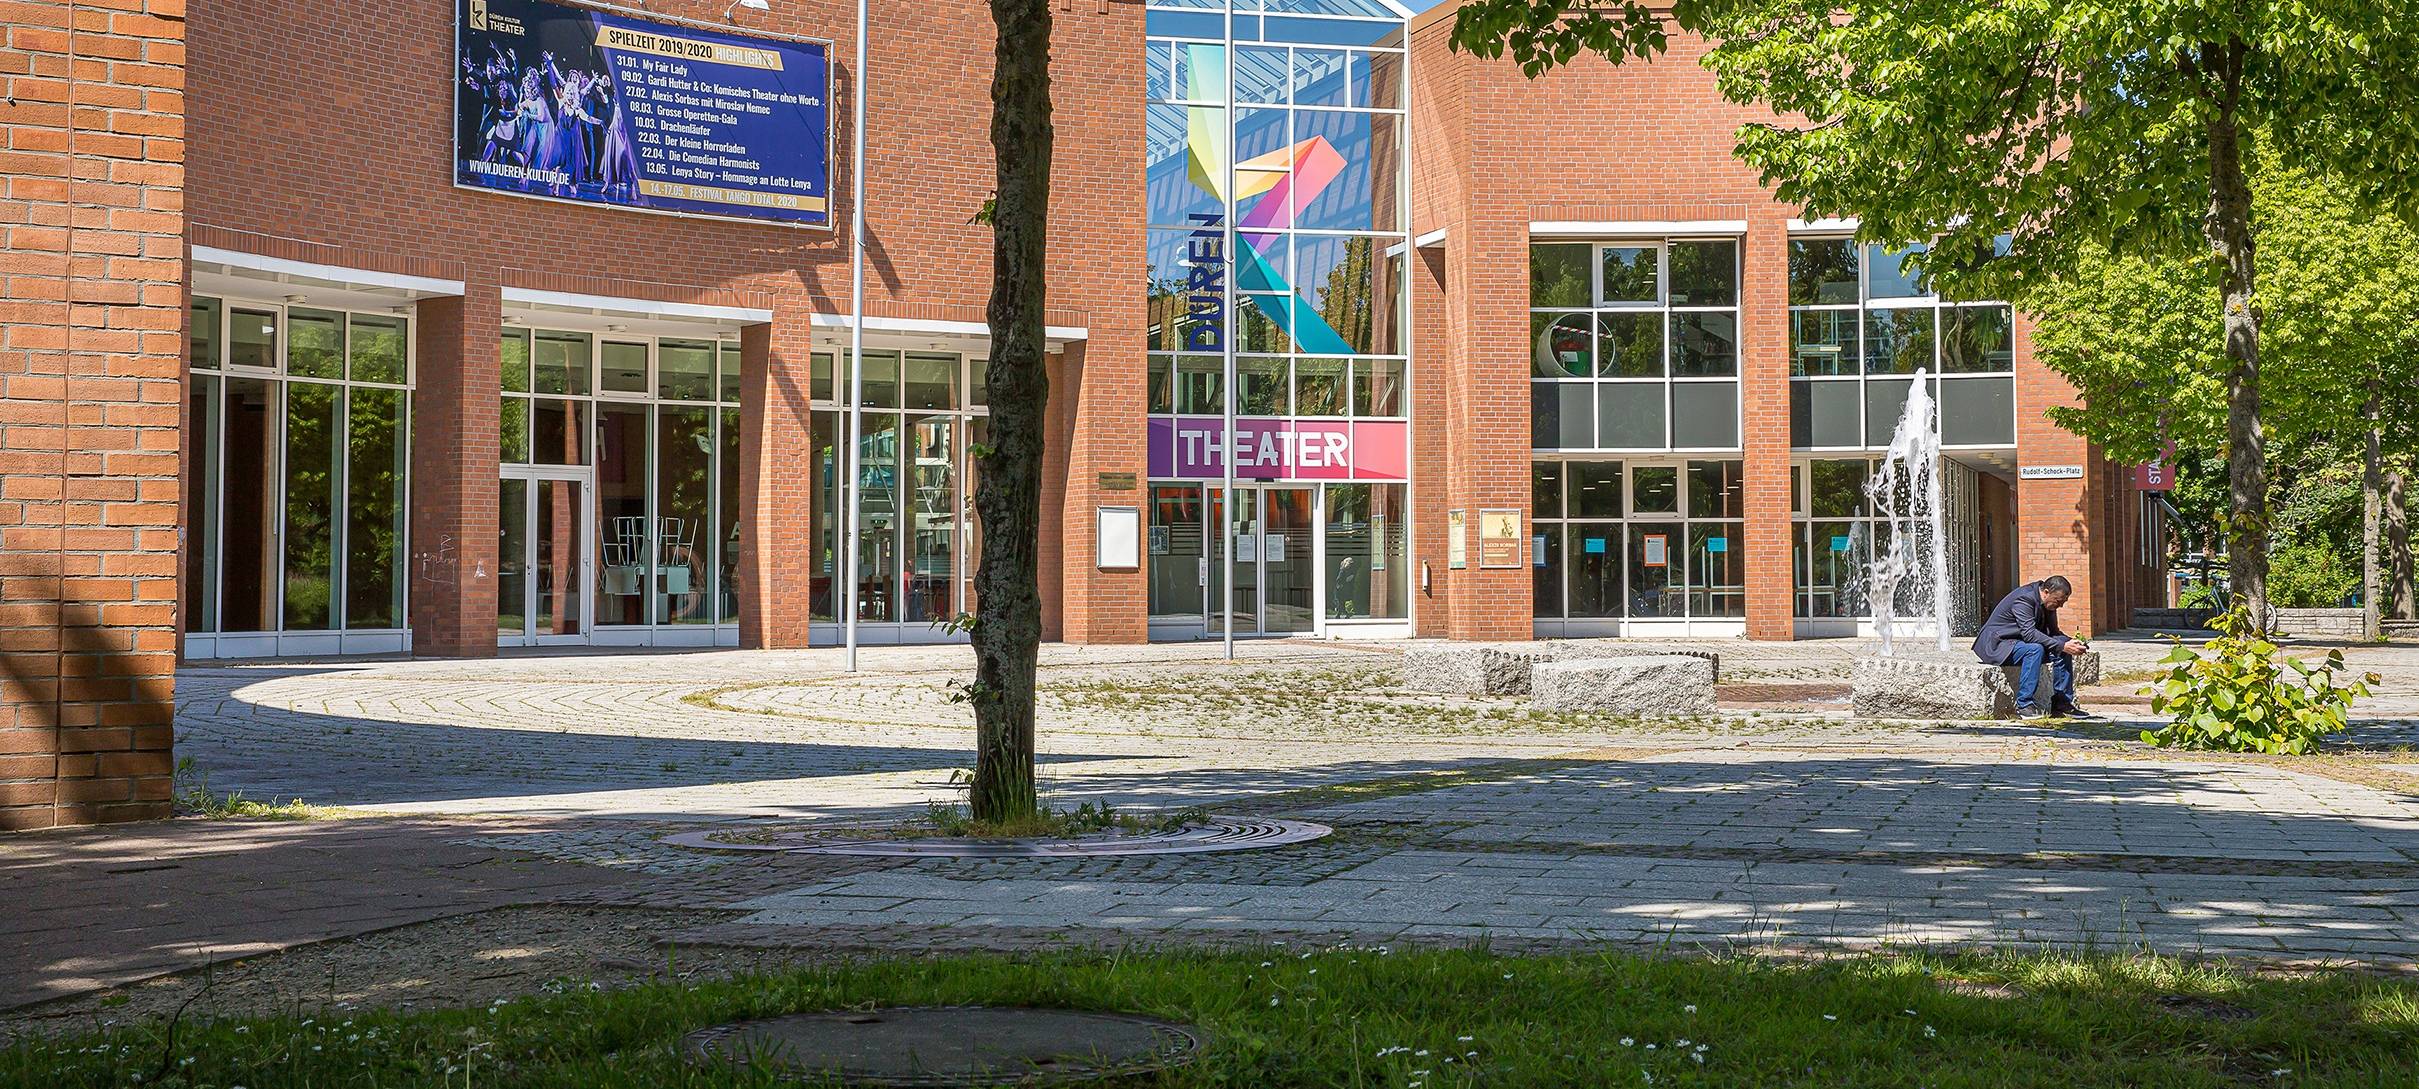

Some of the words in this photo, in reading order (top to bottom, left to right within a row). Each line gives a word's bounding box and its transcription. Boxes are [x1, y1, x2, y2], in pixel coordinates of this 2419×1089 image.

[489, 21, 525, 36] THEATER
[610, 30, 655, 50] SPIELZEIT
[659, 39, 712, 58] 2019/2020
[716, 47, 774, 66] HIGHLIGHTS
[617, 55, 638, 68] 31.01.
[643, 60, 653, 72] My
[656, 61, 669, 72] Fair
[671, 64, 688, 77] Lady
[622, 71, 644, 84] 09.02.
[648, 75, 667, 87] Gardi
[669, 78, 692, 90] Hutter
[694, 82, 699, 92] &
[714, 84, 751, 98] Komisches
[752, 89, 778, 101] Theater
[780, 93, 797, 104] ohne
[799, 94, 819, 106] Worte
[626, 86, 648, 98] 27.02.
[652, 90, 673, 102] Alexis
[675, 93, 699, 106] Sorbas
[701, 97, 713, 108] mit
[716, 98, 744, 112] Miroslav
[747, 102, 770, 114] Nemec
[630, 101, 653, 114] 08.03.
[657, 105, 681, 117] Grosse
[684, 109, 738, 125] Operetten-Gala
[635, 117, 656, 129] 10.03.
[661, 120, 711, 136] Drachenläufer
[638, 132, 660, 144] 22.03.
[665, 135, 678, 146] Der
[680, 137, 701, 149] kleine
[704, 140, 745, 154] Horrorladen
[642, 147, 664, 159] 22.04.
[669, 150, 680, 161] Die
[683, 152, 717, 166] Comedian
[720, 156, 760, 170] Harmonists
[470, 160, 570, 185] WWW.DUEREN-KULTUR.DE
[646, 162, 668, 174] 13.05.
[672, 166, 692, 178] Lenya
[695, 168, 714, 181] Story
[723, 171, 758, 186] Hommage
[760, 176, 768, 185] an
[771, 176, 789, 187] Lotte
[791, 178, 811, 190] Lenya
[690, 188, 723, 200] FESTIVAL
[726, 191, 750, 203] TANGO
[753, 194, 776, 206] TOTAL
[778, 196, 797, 207] 2020
[1189, 213, 1225, 351] DÜREN
[1179, 431, 1348, 467] THEATER
